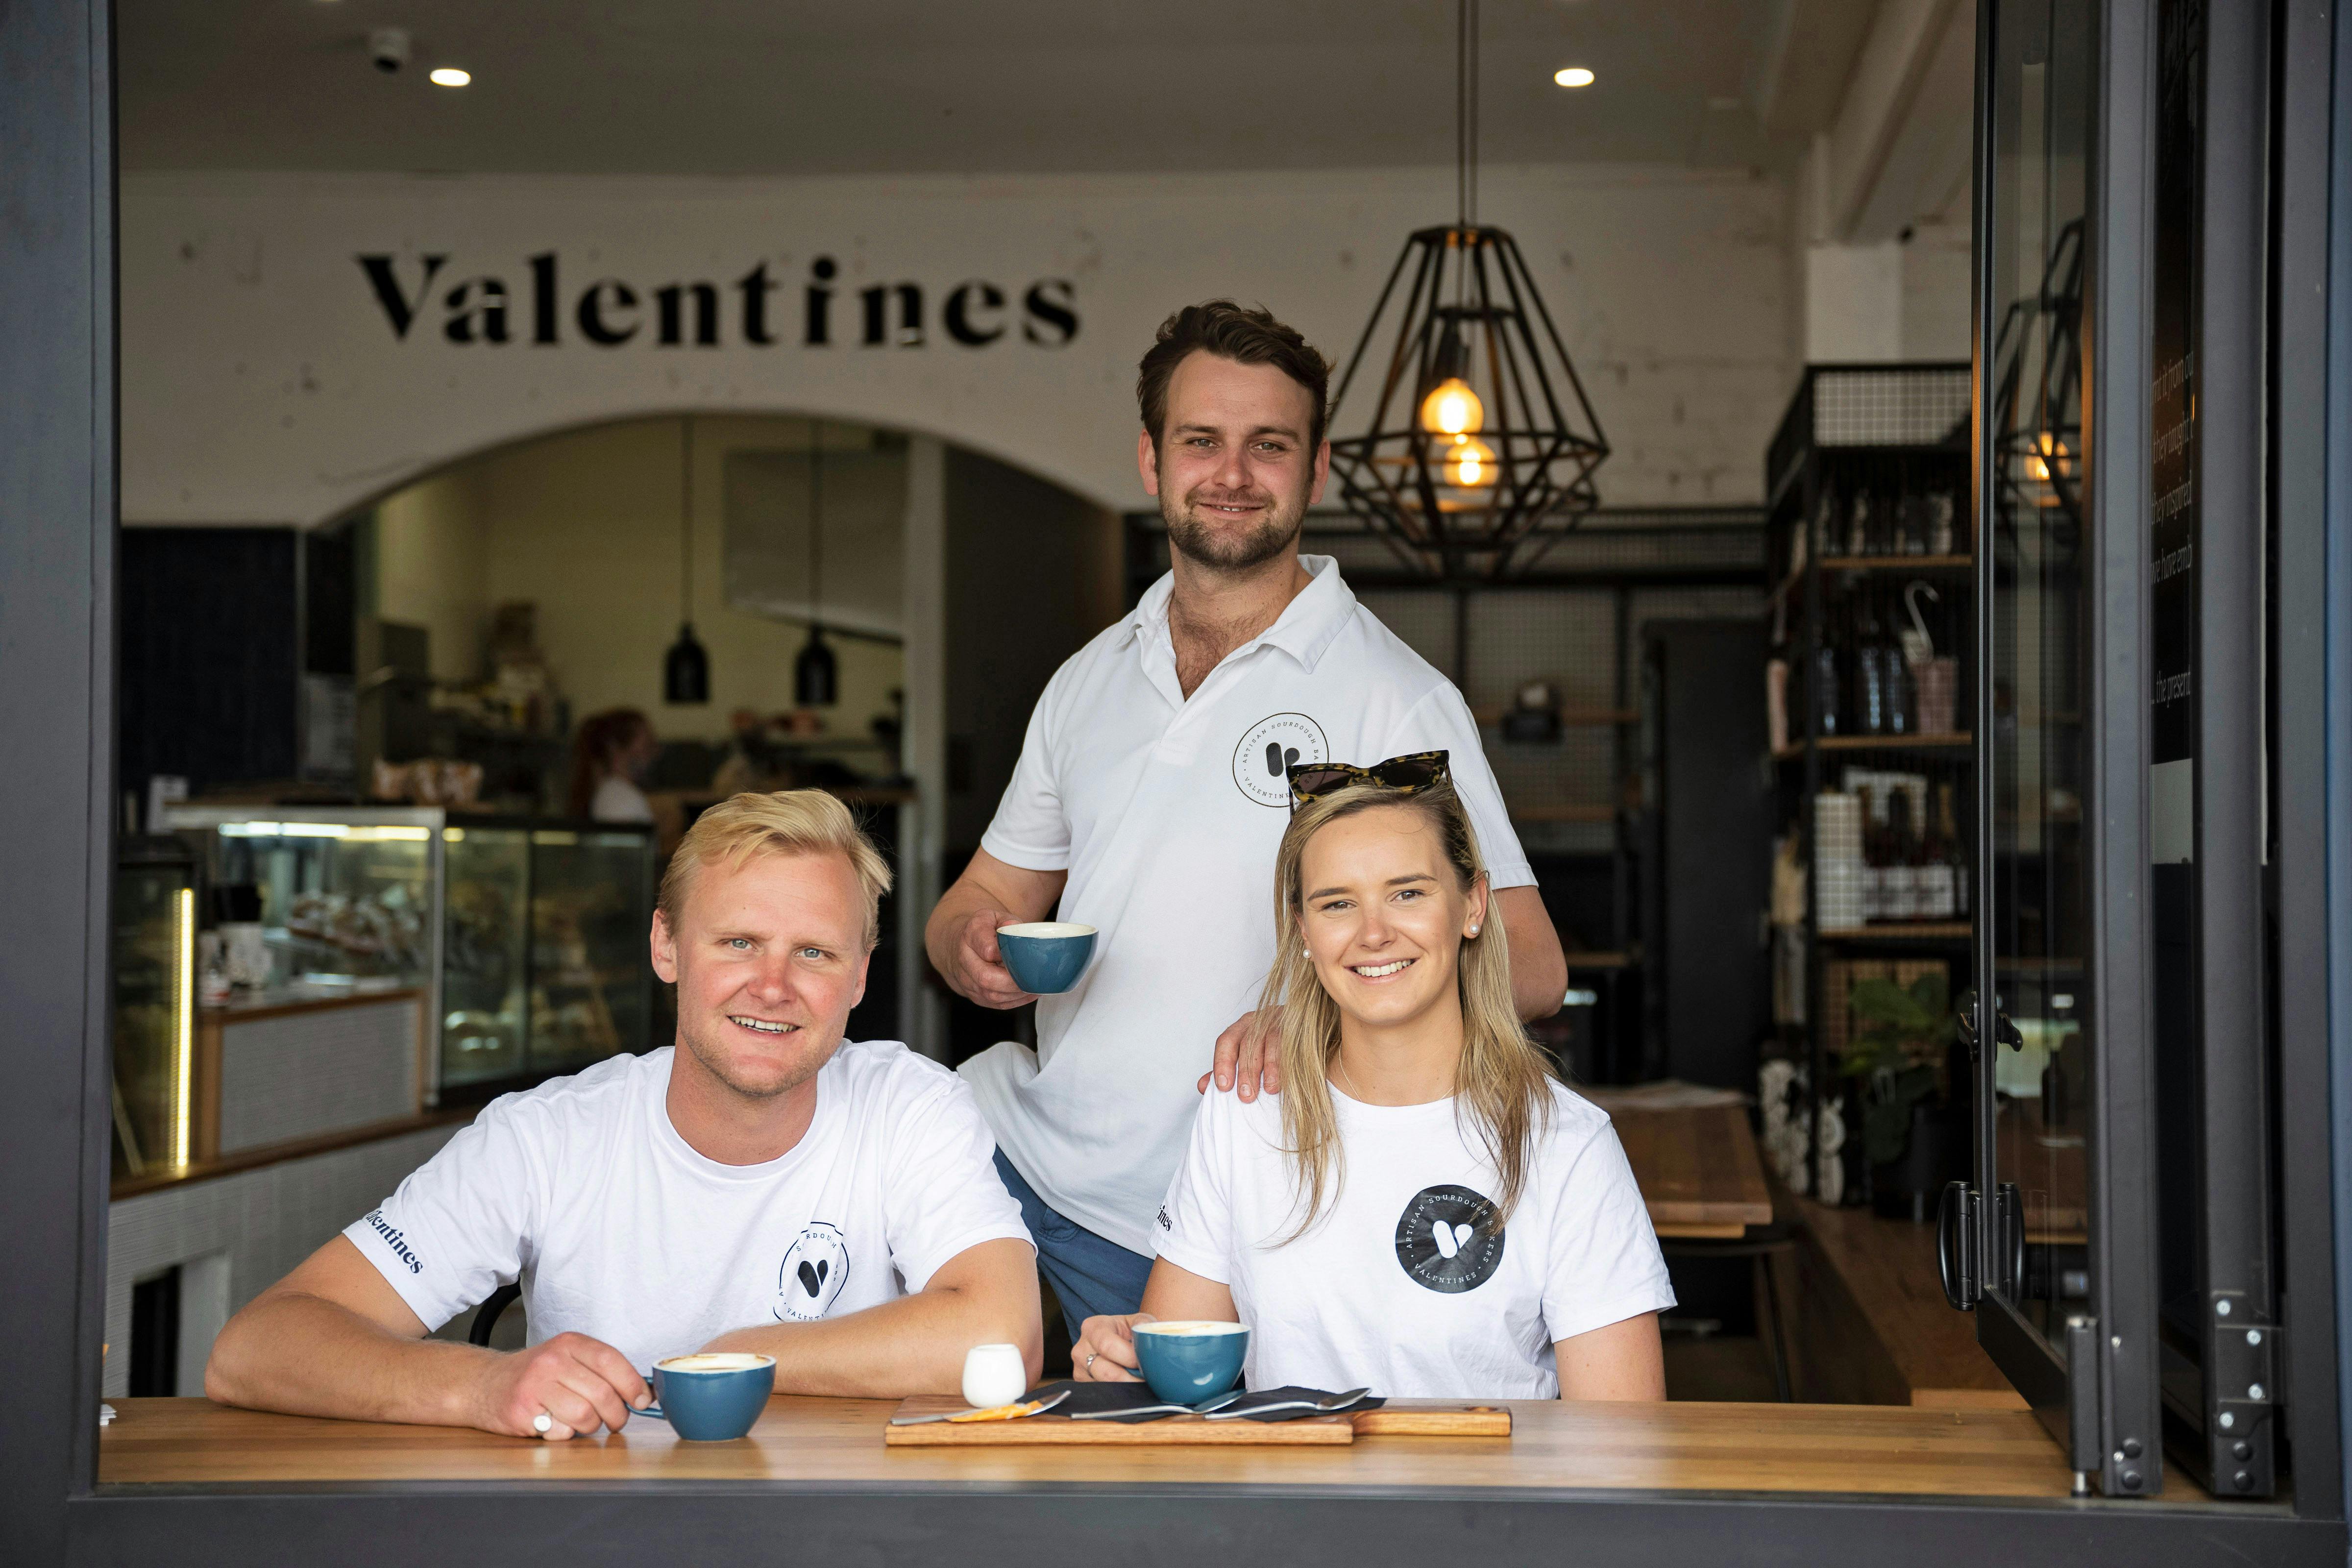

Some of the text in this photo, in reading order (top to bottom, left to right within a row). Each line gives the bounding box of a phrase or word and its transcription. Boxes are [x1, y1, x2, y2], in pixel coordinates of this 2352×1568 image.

[354, 250, 1081, 348] Valentines
[2168, 359, 2184, 401] from
[2153, 430, 2168, 466] they
[2168, 411, 2189, 455] taught
[2152, 469, 2191, 528] they inspired
[2151, 559, 2160, 584] we
[2161, 548, 2176, 581] have
[2156, 664, 2191, 709] the present
[1243, 722, 1319, 784] ARTISAN SOURDOUGH BARS
[1245, 777, 1290, 799] VALENTINE
[796, 1233, 837, 1252] SRDOUH
[1406, 1195, 1495, 1263] ARTISAN SOURDOUGH BKERS
[1415, 1263, 1476, 1284] VALENTINES
[787, 1308, 827, 1322] VALENTI
